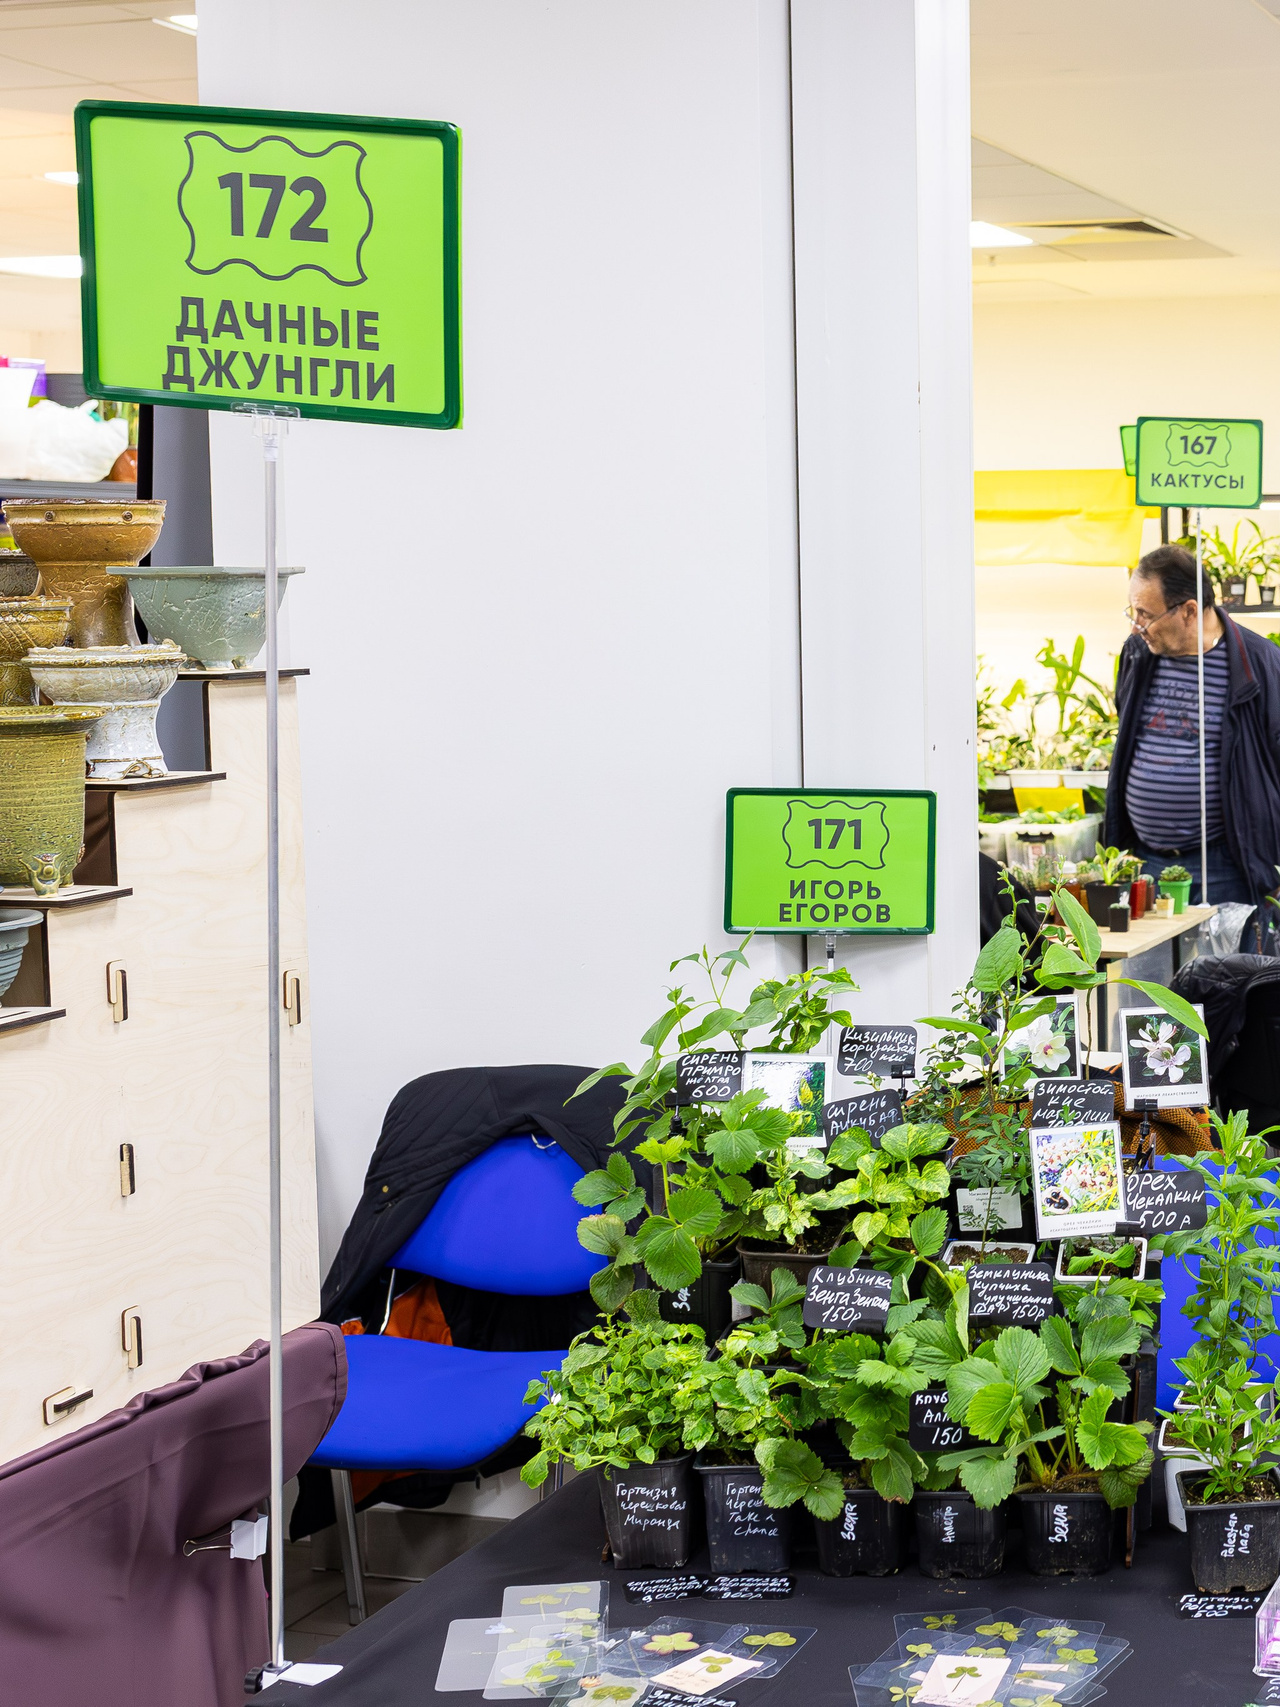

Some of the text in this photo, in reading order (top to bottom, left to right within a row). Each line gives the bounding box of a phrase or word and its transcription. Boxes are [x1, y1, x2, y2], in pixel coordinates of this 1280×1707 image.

[217, 171, 329, 243] 172
[175, 295, 380, 352] ДАЧНЫЕ
[161, 344, 396, 403] ДЖУНГЛИ
[1179, 435, 1217, 455] 167
[1150, 472, 1244, 490] КАКТУСЫ
[807, 818, 862, 850] 171
[789, 879, 882, 900] ИГОРЬ
[779, 903, 891, 924] ЕГОРОВ
[844, 1056, 873, 1073] 700
[691, 1085, 731, 1098] 600
[1139, 1210, 1178, 1229] 500
[931, 1426, 963, 1446] 150
